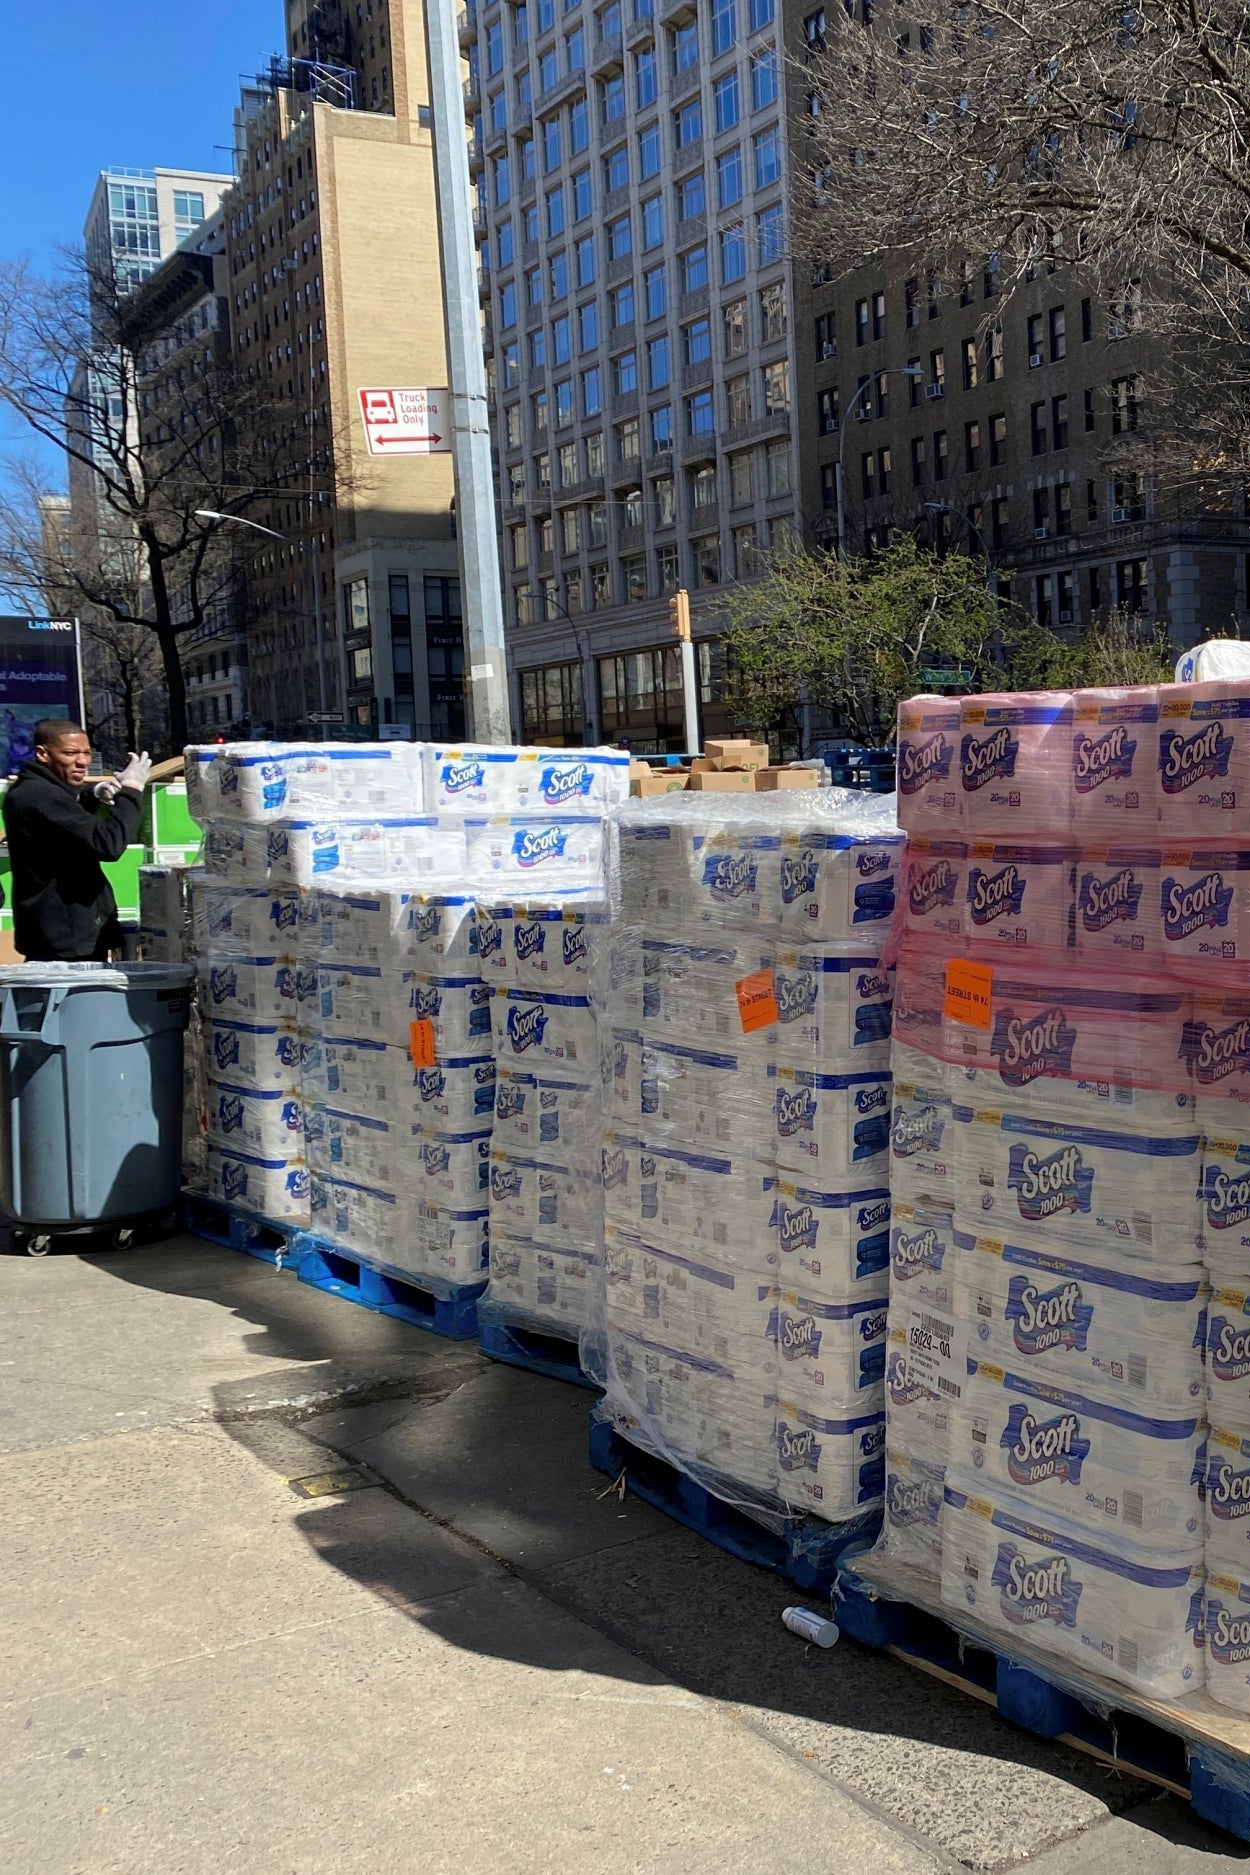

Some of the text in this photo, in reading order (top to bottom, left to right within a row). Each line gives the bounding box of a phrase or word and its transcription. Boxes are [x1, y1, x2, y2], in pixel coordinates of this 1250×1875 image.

[399, 393, 426, 402] Truck
[400, 404, 438, 414] Loading
[403, 415, 424, 426] Only
[28, 621, 72, 631] LinkNYC
[8, 671, 66, 682] Adoptable
[903, 732, 944, 780] Scott
[965, 728, 1009, 777] Scott
[1077, 726, 1126, 777] Scott
[1165, 722, 1221, 777] Scott
[448, 763, 479, 786] Scott
[547, 764, 586, 795] Scott
[976, 766, 995, 786] 1000
[1089, 766, 1110, 787] 1000
[1180, 765, 1204, 786] 1000
[559, 787, 576, 801] 1000
[520, 826, 560, 858] Scott
[974, 866, 1015, 910] Scott
[1086, 869, 1132, 916] Scott
[1167, 872, 1221, 924] Scott
[986, 901, 1003, 920] 1000
[1100, 908, 1118, 927] 1000
[479, 921, 497, 950] Scott
[1182, 913, 1204, 935] 1000
[518, 923, 541, 950] Scott
[752, 989, 772, 1003] STREET
[948, 986, 973, 1001] STREET
[513, 1005, 543, 1041] Scott
[1004, 1010, 1063, 1065] Scott
[1198, 1021, 1249, 1067] Scott
[1021, 1059, 1044, 1081] 1000
[1212, 1059, 1233, 1079] 1000
[861, 1088, 884, 1108] Scott
[895, 1106, 936, 1144] Scott
[1022, 1147, 1079, 1199] Scott
[863, 1203, 888, 1226] Scott
[1040, 1193, 1063, 1215] 1000
[781, 1207, 811, 1239] Scott
[1226, 1208, 1247, 1224] 1000
[896, 1230, 935, 1266] Scott
[1018, 1283, 1079, 1333] Scott
[782, 1317, 815, 1348] Scott
[1034, 1330, 1060, 1350] 1000
[782, 1430, 815, 1459] Scott
[1014, 1416, 1076, 1462] Scott
[1030, 1460, 1054, 1480] 1000
[1230, 1501, 1250, 1517] 1000
[1006, 1555, 1067, 1601] Scott
[1022, 1602, 1047, 1620] 1000
[1229, 1647, 1250, 1661] 1000
